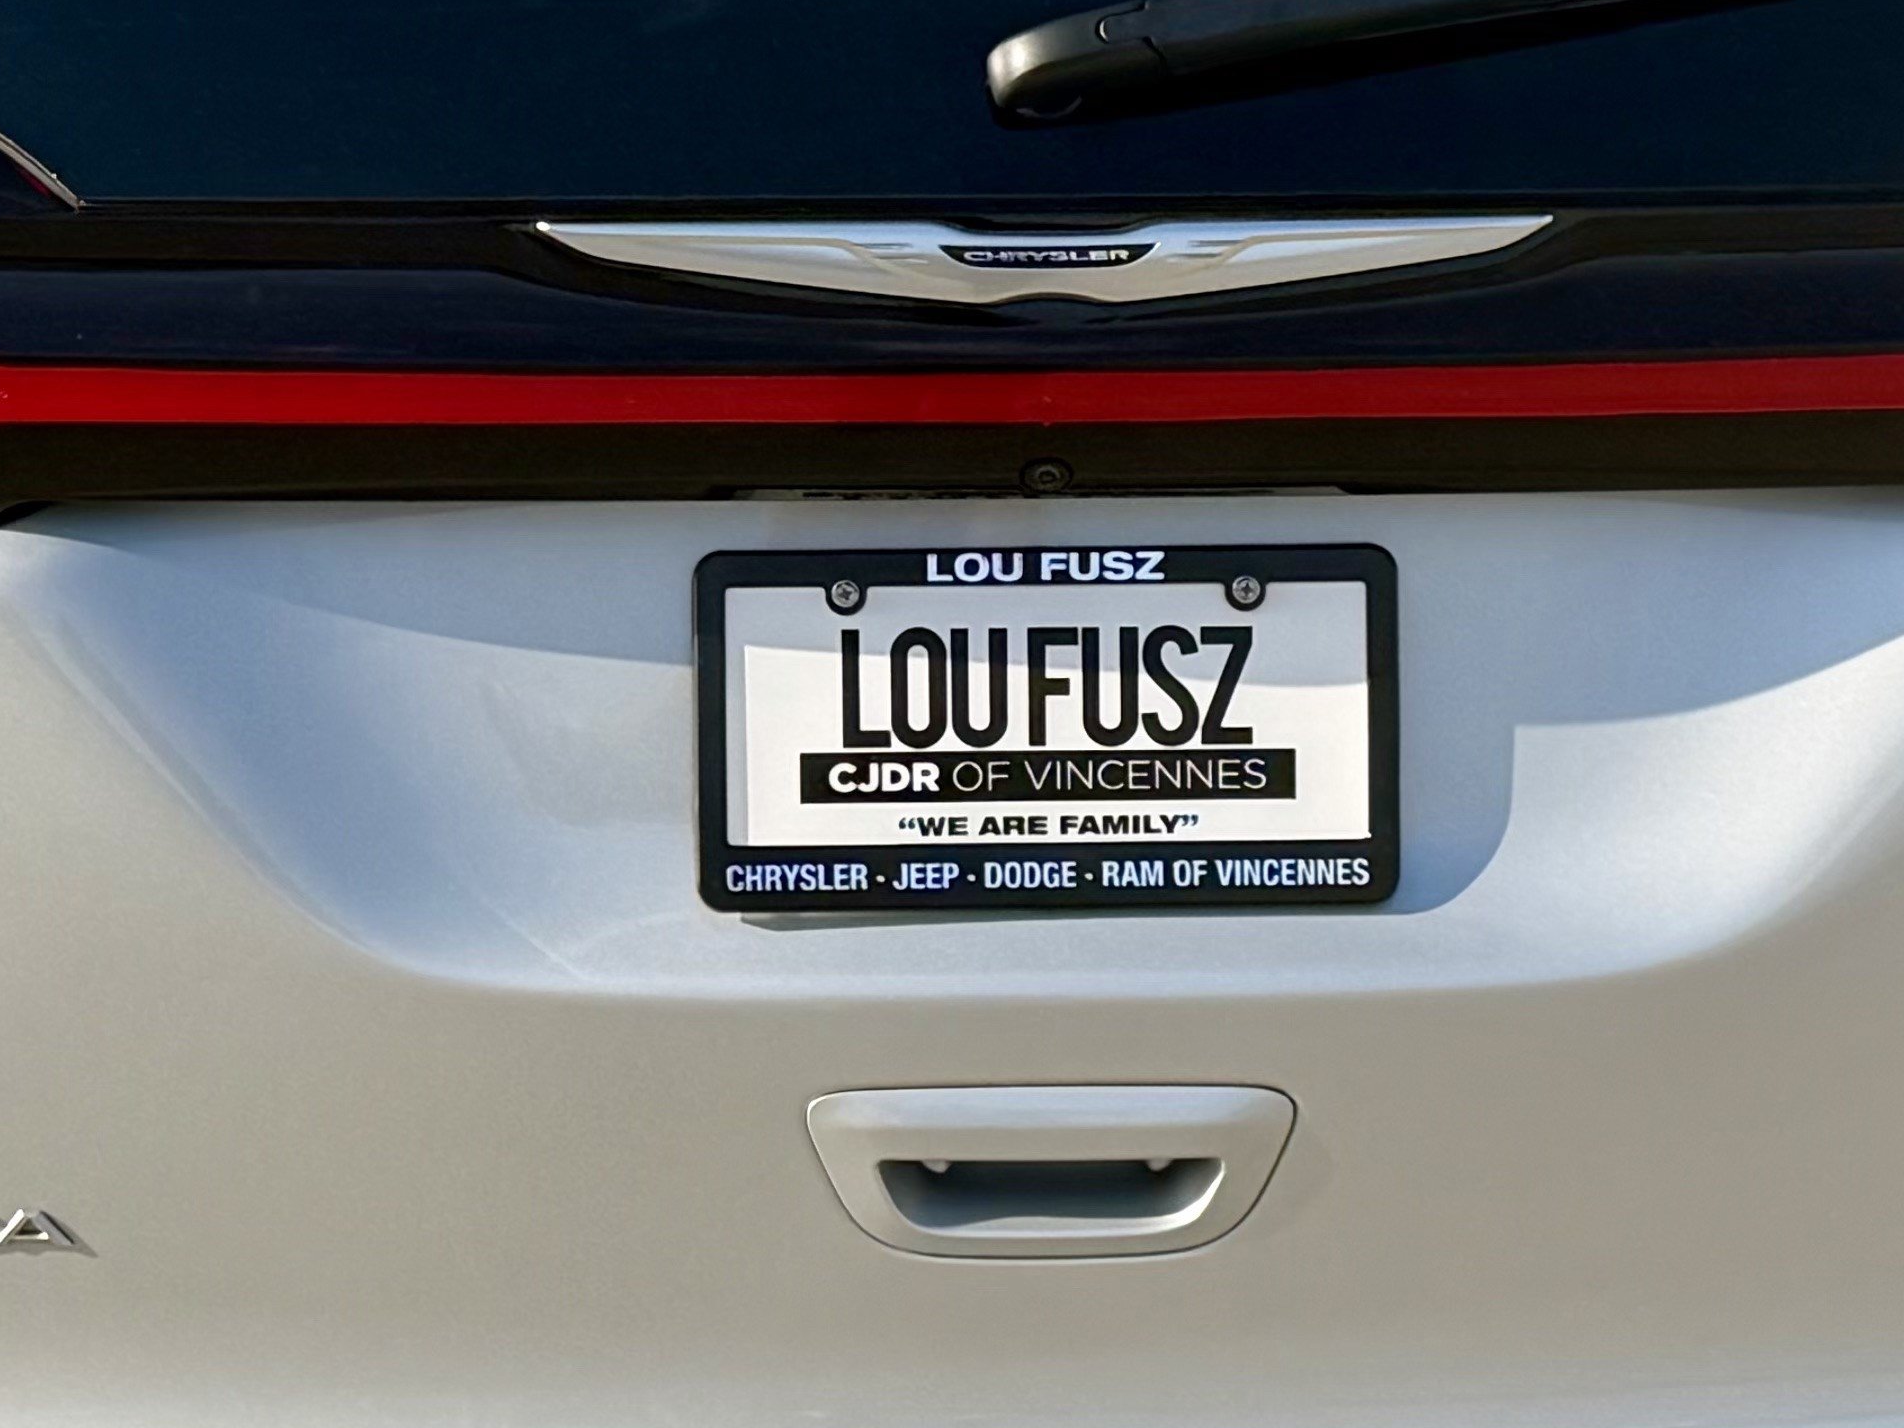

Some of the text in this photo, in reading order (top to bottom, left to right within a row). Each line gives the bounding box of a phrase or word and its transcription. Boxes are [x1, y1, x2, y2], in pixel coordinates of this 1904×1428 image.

[962, 248, 1130, 263] CHRYSLER
[925, 550, 1166, 583] LOU FUSZ
[840, 625, 1254, 749] LOU FUSZ
[828, 758, 1267, 794] CJDR OF VINCENNES
[977, 815, 1049, 837] ARE
[725, 857, 1371, 892] CHRYSLER JEEP DODGE RAM OF VINCENNES
